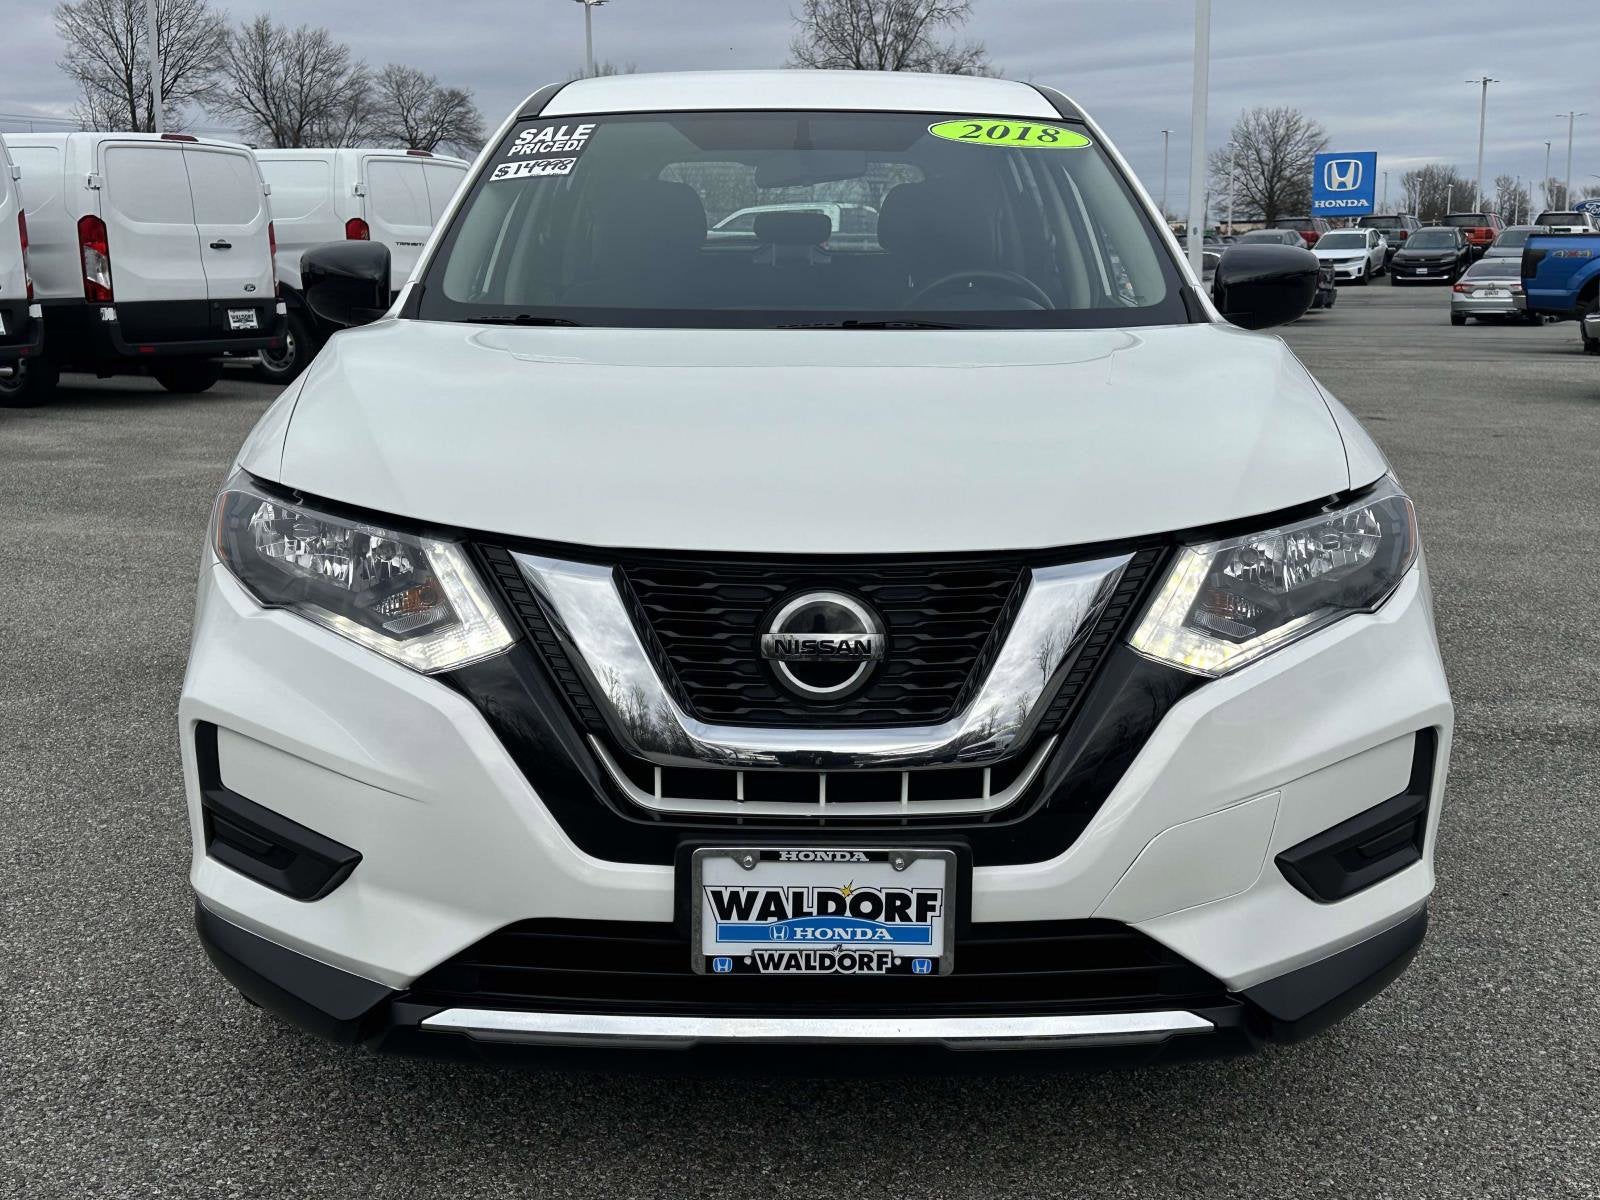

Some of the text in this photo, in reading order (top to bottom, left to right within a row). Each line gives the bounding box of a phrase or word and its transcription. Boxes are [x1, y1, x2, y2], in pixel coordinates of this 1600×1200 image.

[515, 124, 596, 145] SALE
[959, 124, 1060, 143] 2018
[507, 140, 585, 157] PRICED!
[1314, 199, 1370, 208] HONDA
[774, 639, 872, 655] NISSAN
[779, 851, 869, 862] HONDA
[710, 890, 939, 922] WALDORF
[793, 927, 893, 940] HONDA
[757, 953, 892, 971] WALDORF
